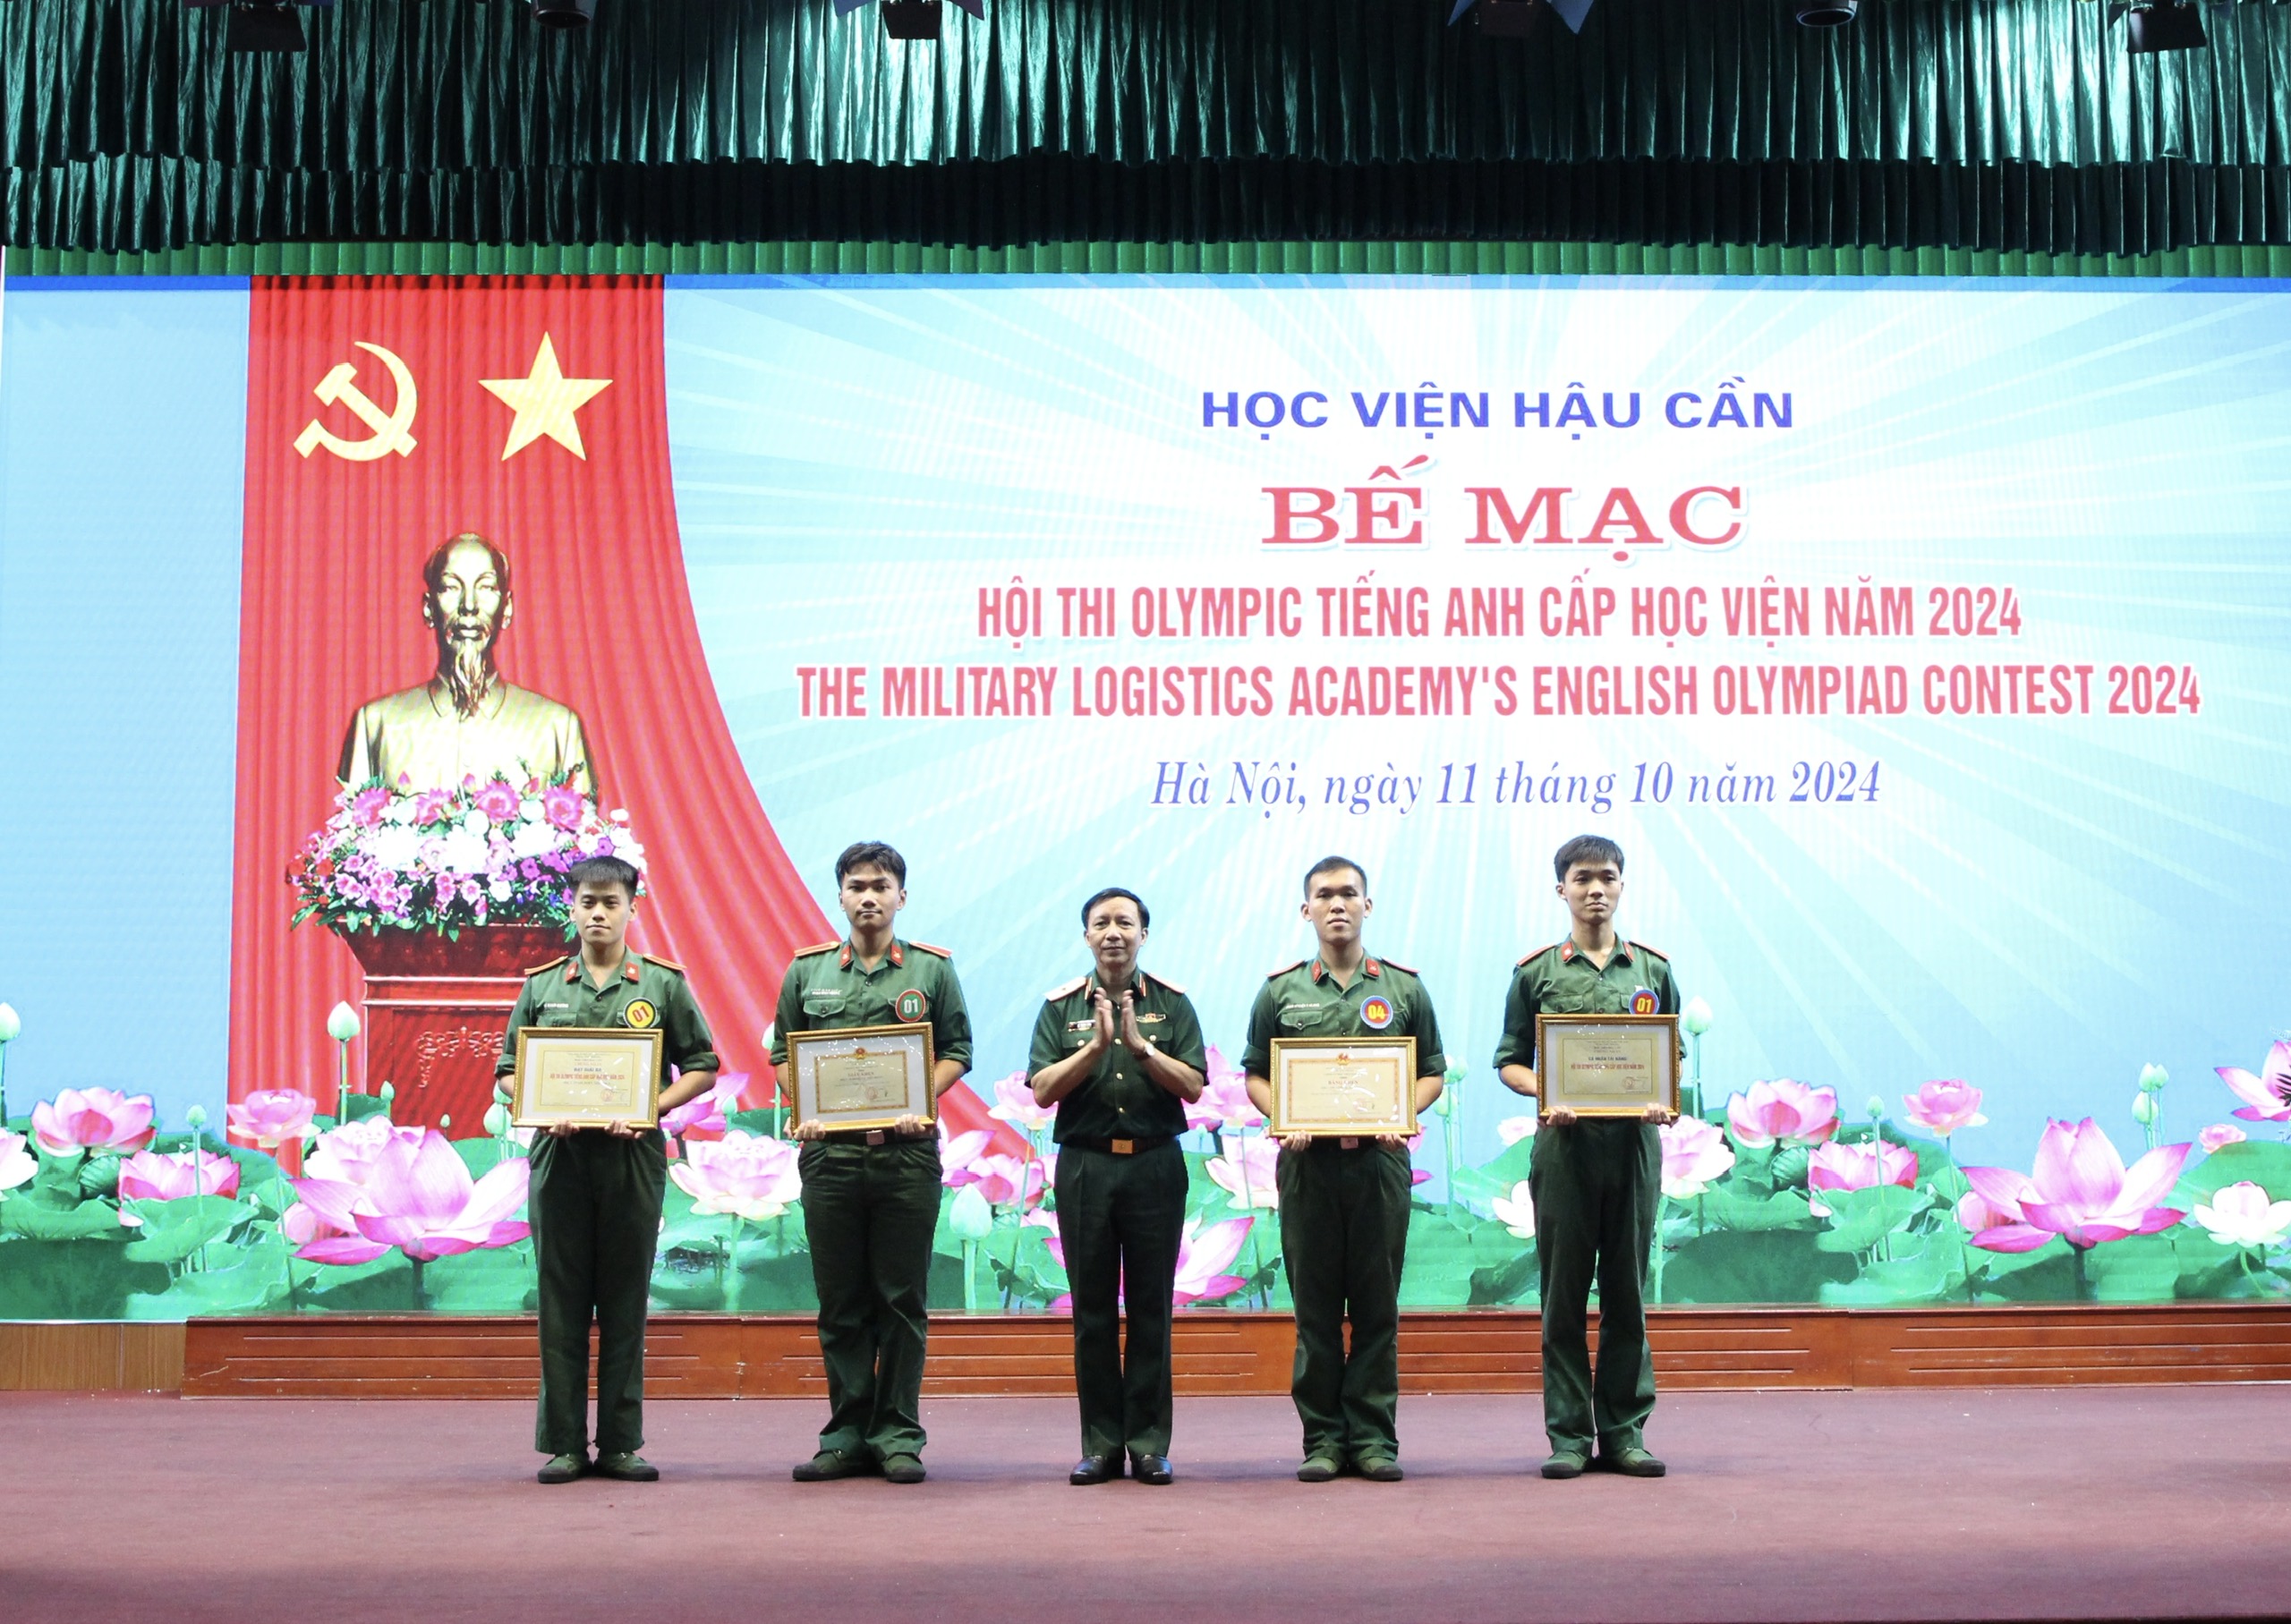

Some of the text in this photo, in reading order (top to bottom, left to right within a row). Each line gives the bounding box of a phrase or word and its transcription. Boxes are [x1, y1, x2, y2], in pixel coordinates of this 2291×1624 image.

[1203, 376, 1793, 440] HỌC VIỆN HẬU CẦN
[1262, 454, 1742, 562] BẾ MẠC
[978, 567, 2022, 649] HỘI THI OLYMPIC TIẾNG ANH CẤP HỌC VIỆN NĂM 2024
[796, 664, 2202, 717] THE MILITARY LOGISTICS ACADEMY'S ENGLISH OLYMPIAD CONTEST 2024
[1151, 760, 1880, 819] Hà Nội, ngày 11 tháng 10 năm 2024
[632, 1006, 650, 1023] 01
[1368, 1005, 1385, 1020] 04
[1637, 997, 1652, 1013] 01
